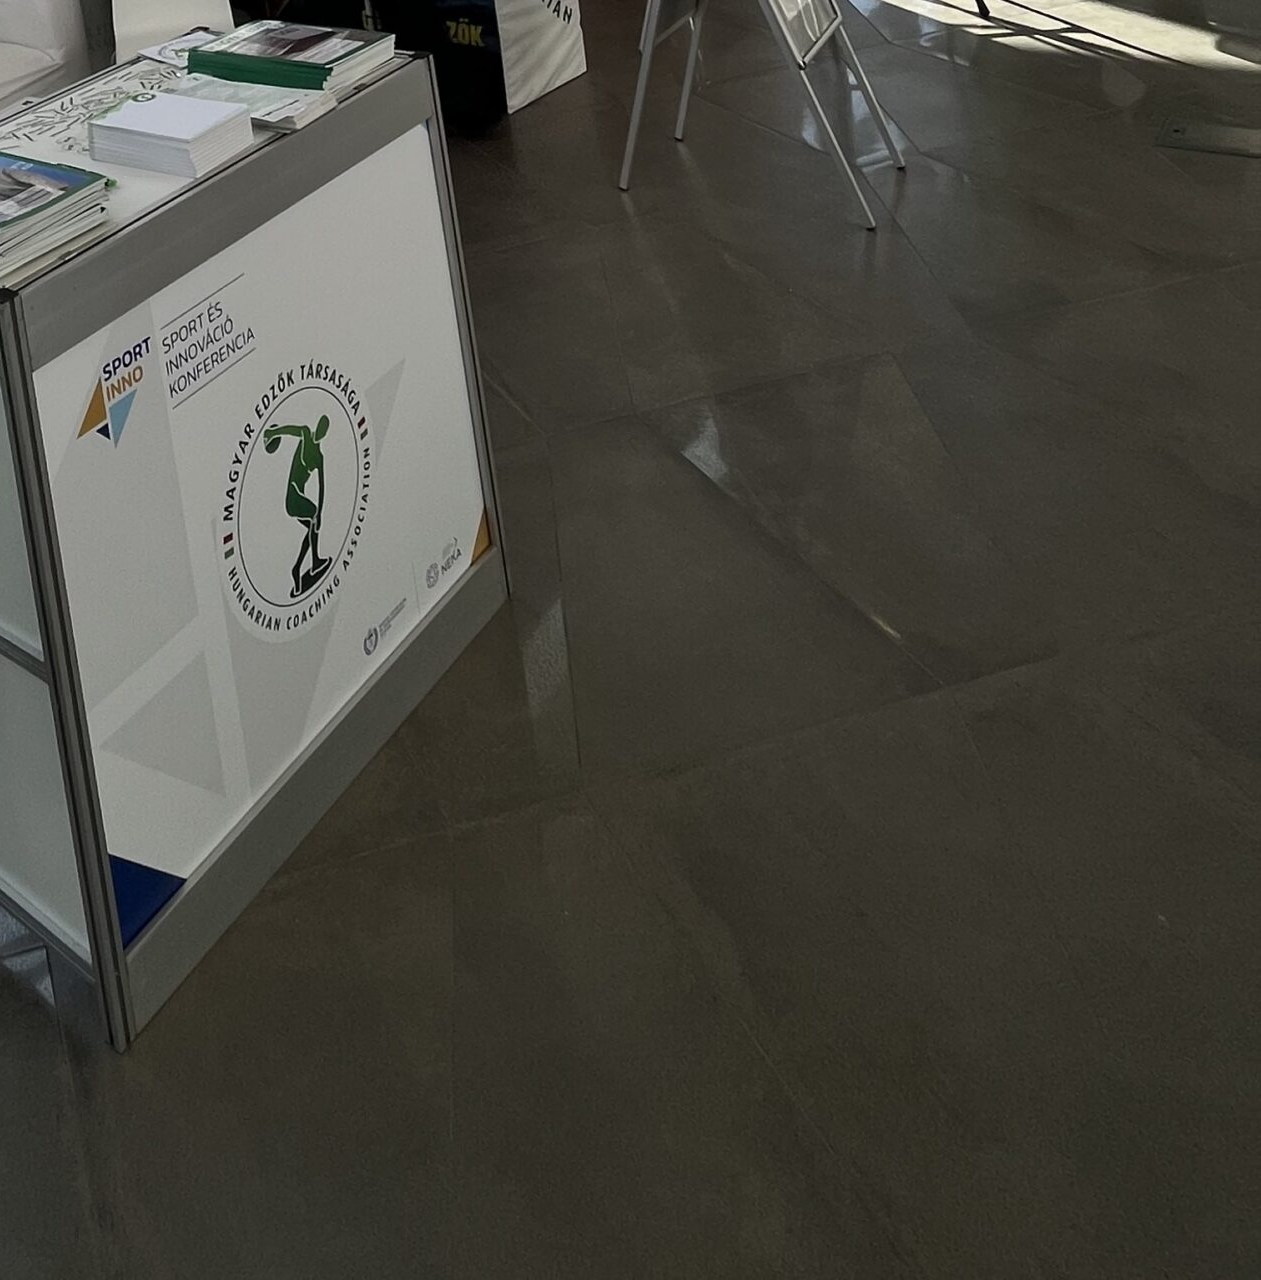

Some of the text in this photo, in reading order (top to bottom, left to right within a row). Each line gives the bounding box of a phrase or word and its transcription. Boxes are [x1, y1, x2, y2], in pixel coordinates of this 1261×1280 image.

[161, 300, 224, 354] SPORT ÉS
[165, 314, 234, 377] INNOVÁCIÓ
[102, 336, 152, 382] SPORT
[105, 365, 144, 402] INNO
[168, 327, 256, 399] KONFERENCIA
[223, 359, 361, 522] MAGYAR EDZŐK TÁRSASÁGA
[228, 566, 282, 632] HUNGARIAN
[286, 577, 341, 632] COACHING
[342, 447, 372, 572] ASSOCIATION
